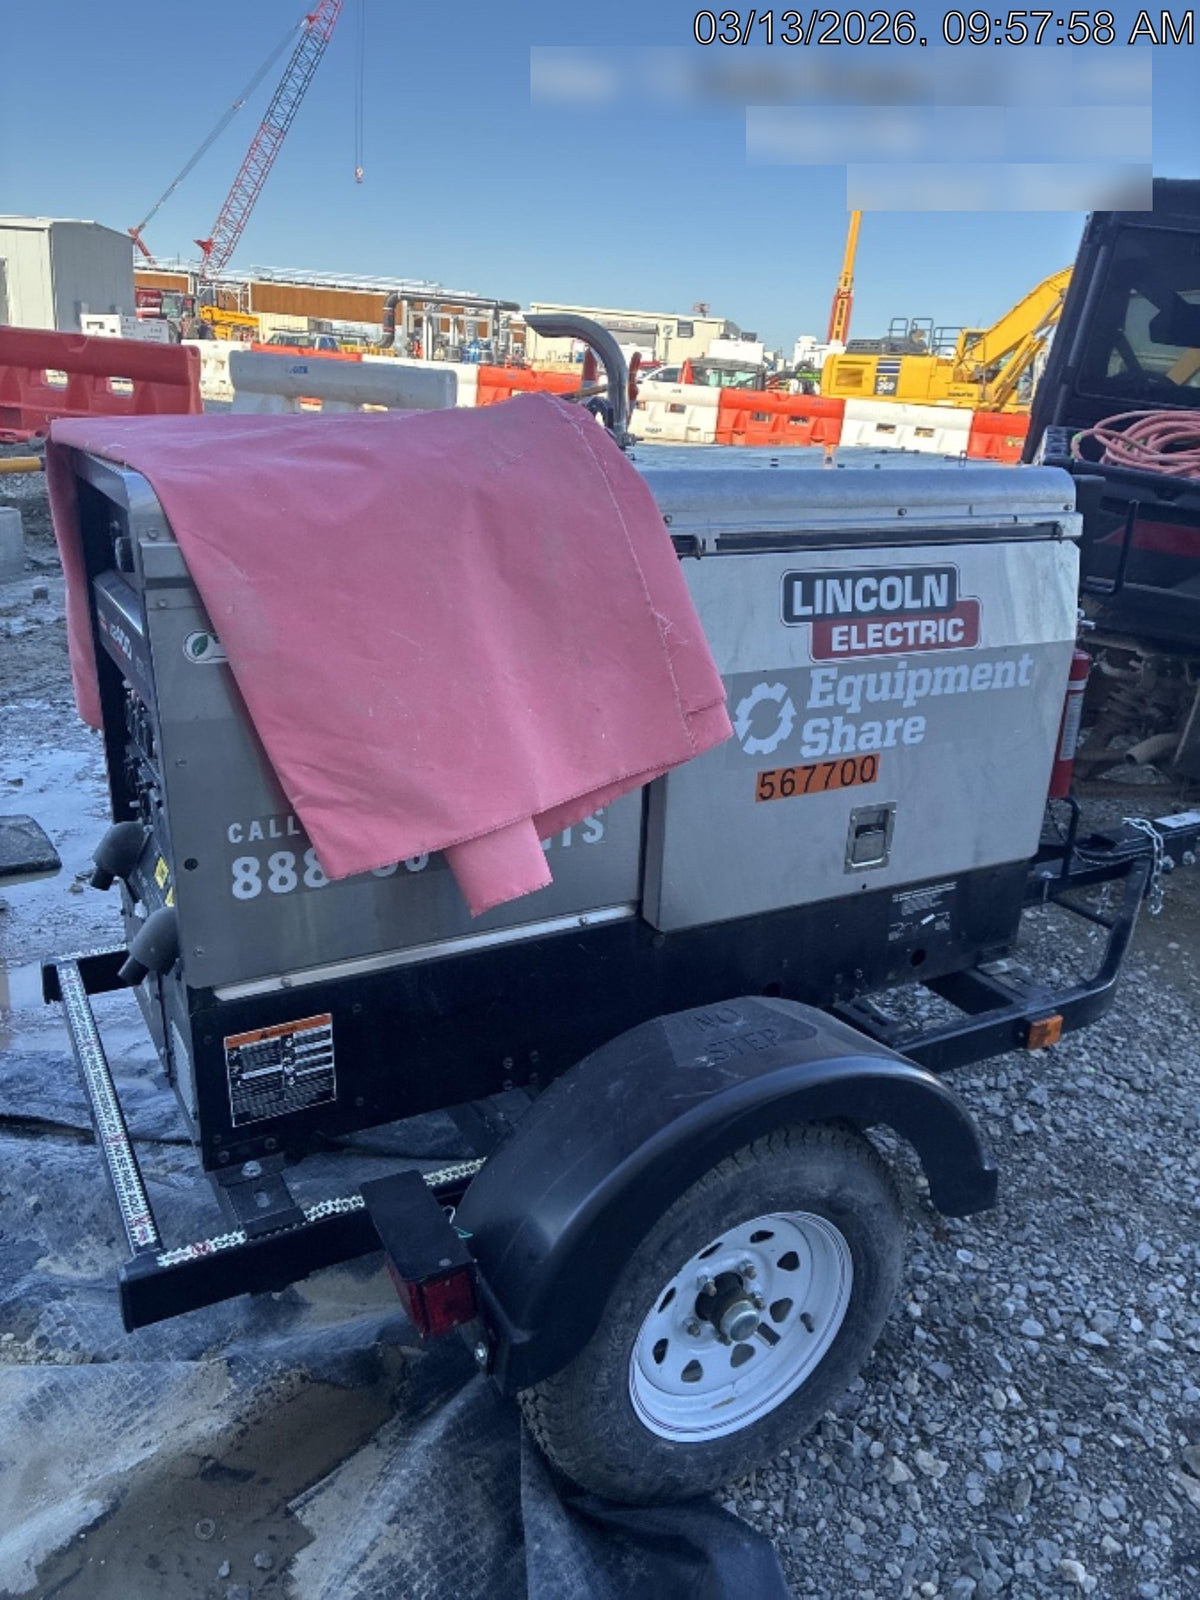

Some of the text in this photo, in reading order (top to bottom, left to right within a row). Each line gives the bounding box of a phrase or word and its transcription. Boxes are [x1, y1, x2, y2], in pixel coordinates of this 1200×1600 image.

[792, 573, 949, 616] LINCOLN
[830, 618, 965, 652] ELECTRIC
[806, 653, 1035, 714] Equipment
[800, 715, 926, 758] Share
[758, 755, 877, 801] 567700
[227, 815, 301, 844] CALL
[691, 1006, 744, 1032] NO
[704, 1027, 780, 1063] STEP
